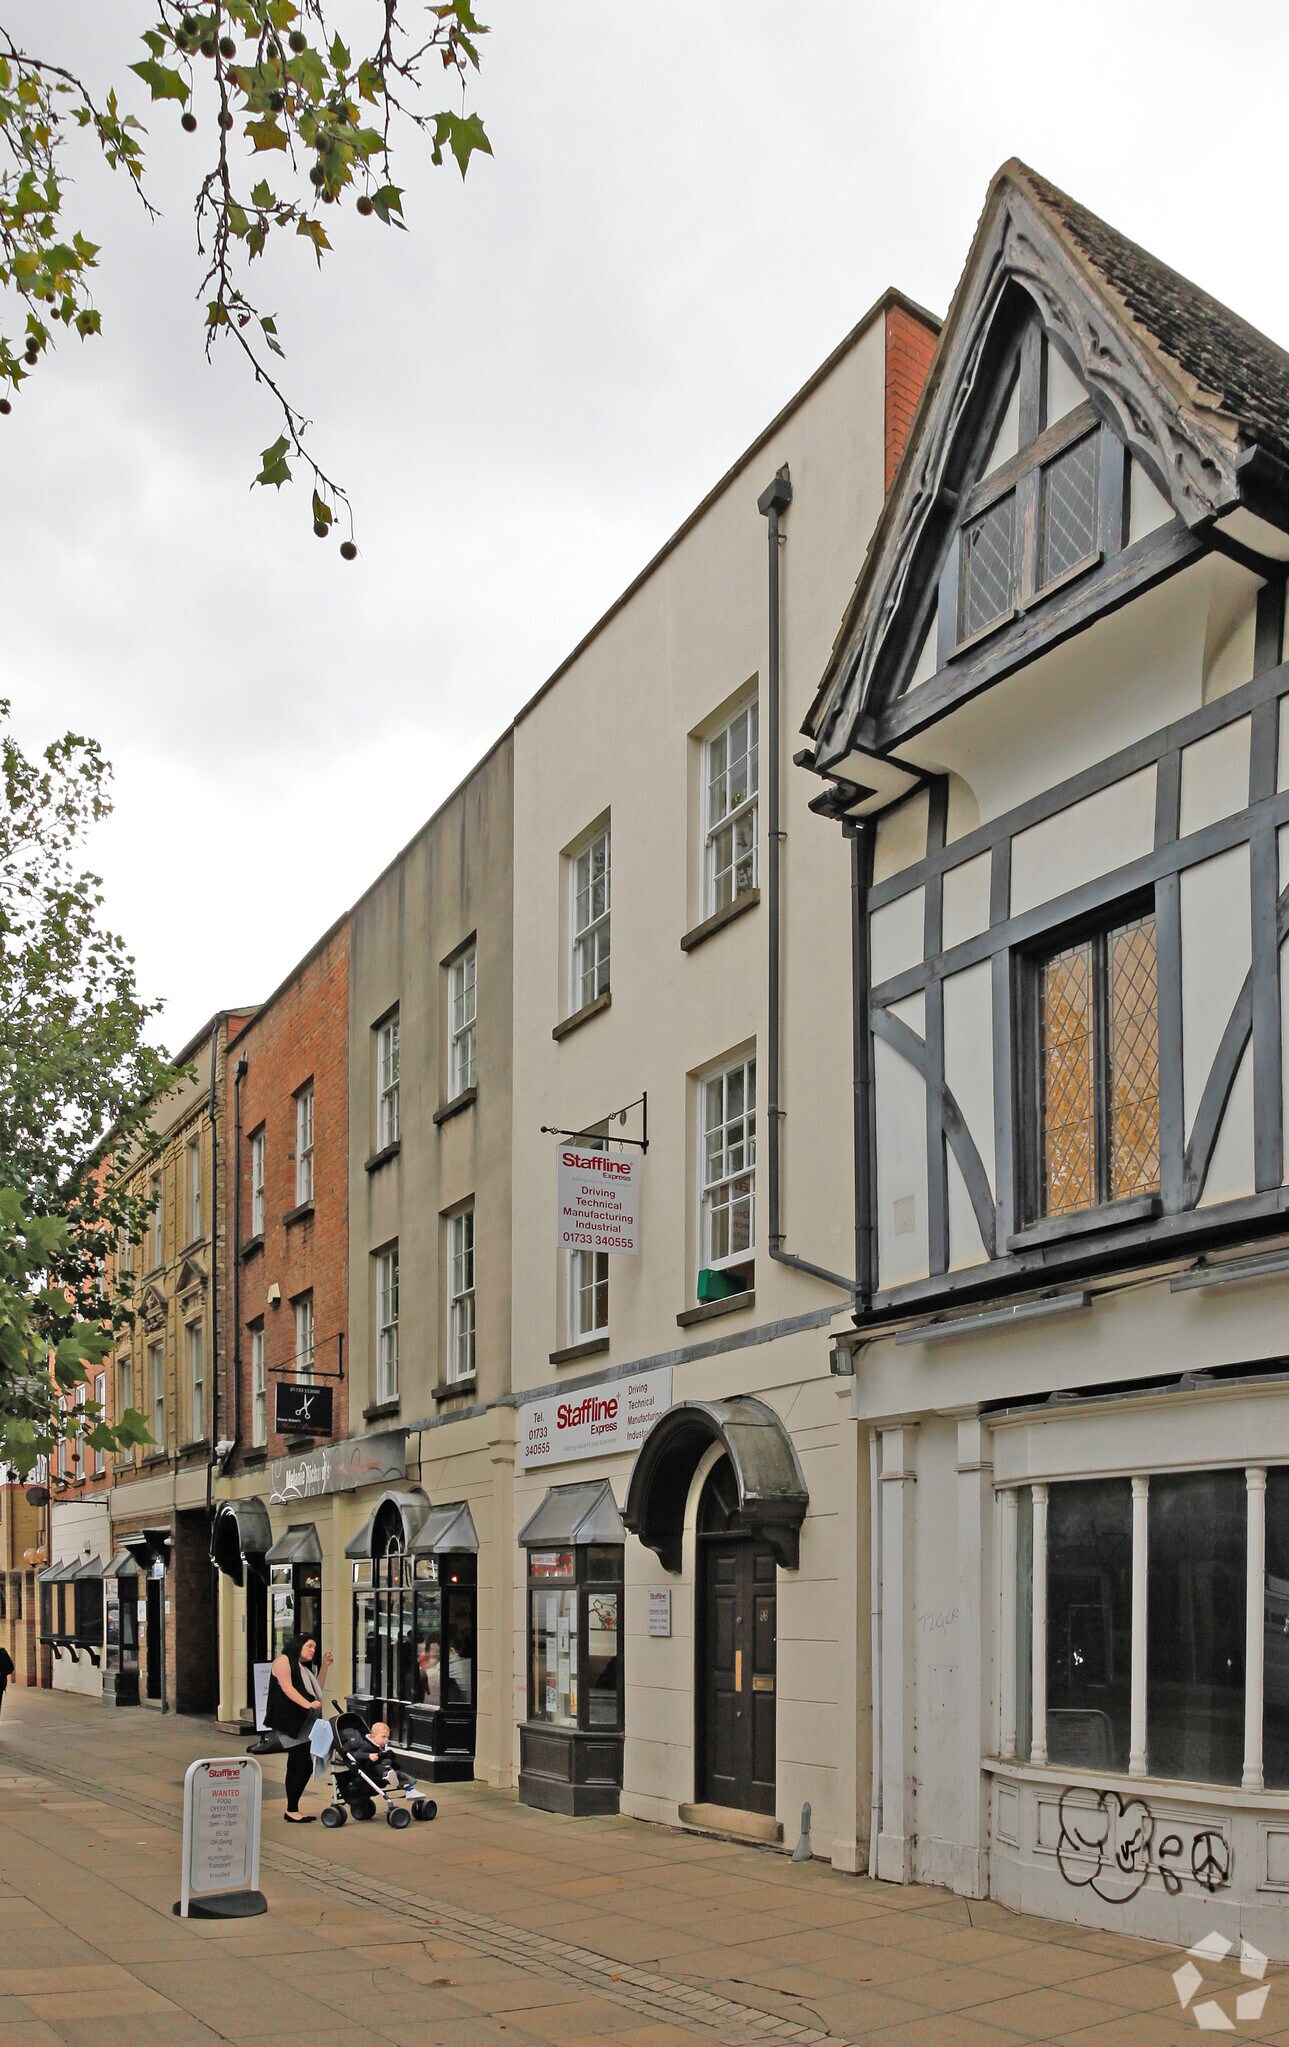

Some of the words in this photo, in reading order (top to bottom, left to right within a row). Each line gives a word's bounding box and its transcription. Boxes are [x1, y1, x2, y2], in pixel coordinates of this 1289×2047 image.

[562, 1152, 631, 1174] Staffline
[602, 1172, 631, 1182] Express
[581, 1186, 616, 1199] Driving
[575, 1197, 622, 1210] Technical
[563, 1207, 634, 1224] Manufacturing
[575, 1220, 621, 1233] Industrial
[563, 1232, 592, 1244] 01733
[595, 1236, 634, 1248] 340555
[628, 1383, 648, 1395] Driving
[628, 1396, 655, 1410] Technical
[534, 1412, 545, 1424] Tel.
[557, 1397, 618, 1429] Staffline
[528, 1427, 548, 1441] 01733
[590, 1422, 618, 1436] Express
[525, 1442, 550, 1457] 340555
[208, 1768, 240, 1778] Staffline
[211, 1789, 240, 1797] WANTED
[209, 1871, 231, 1879] Provided
